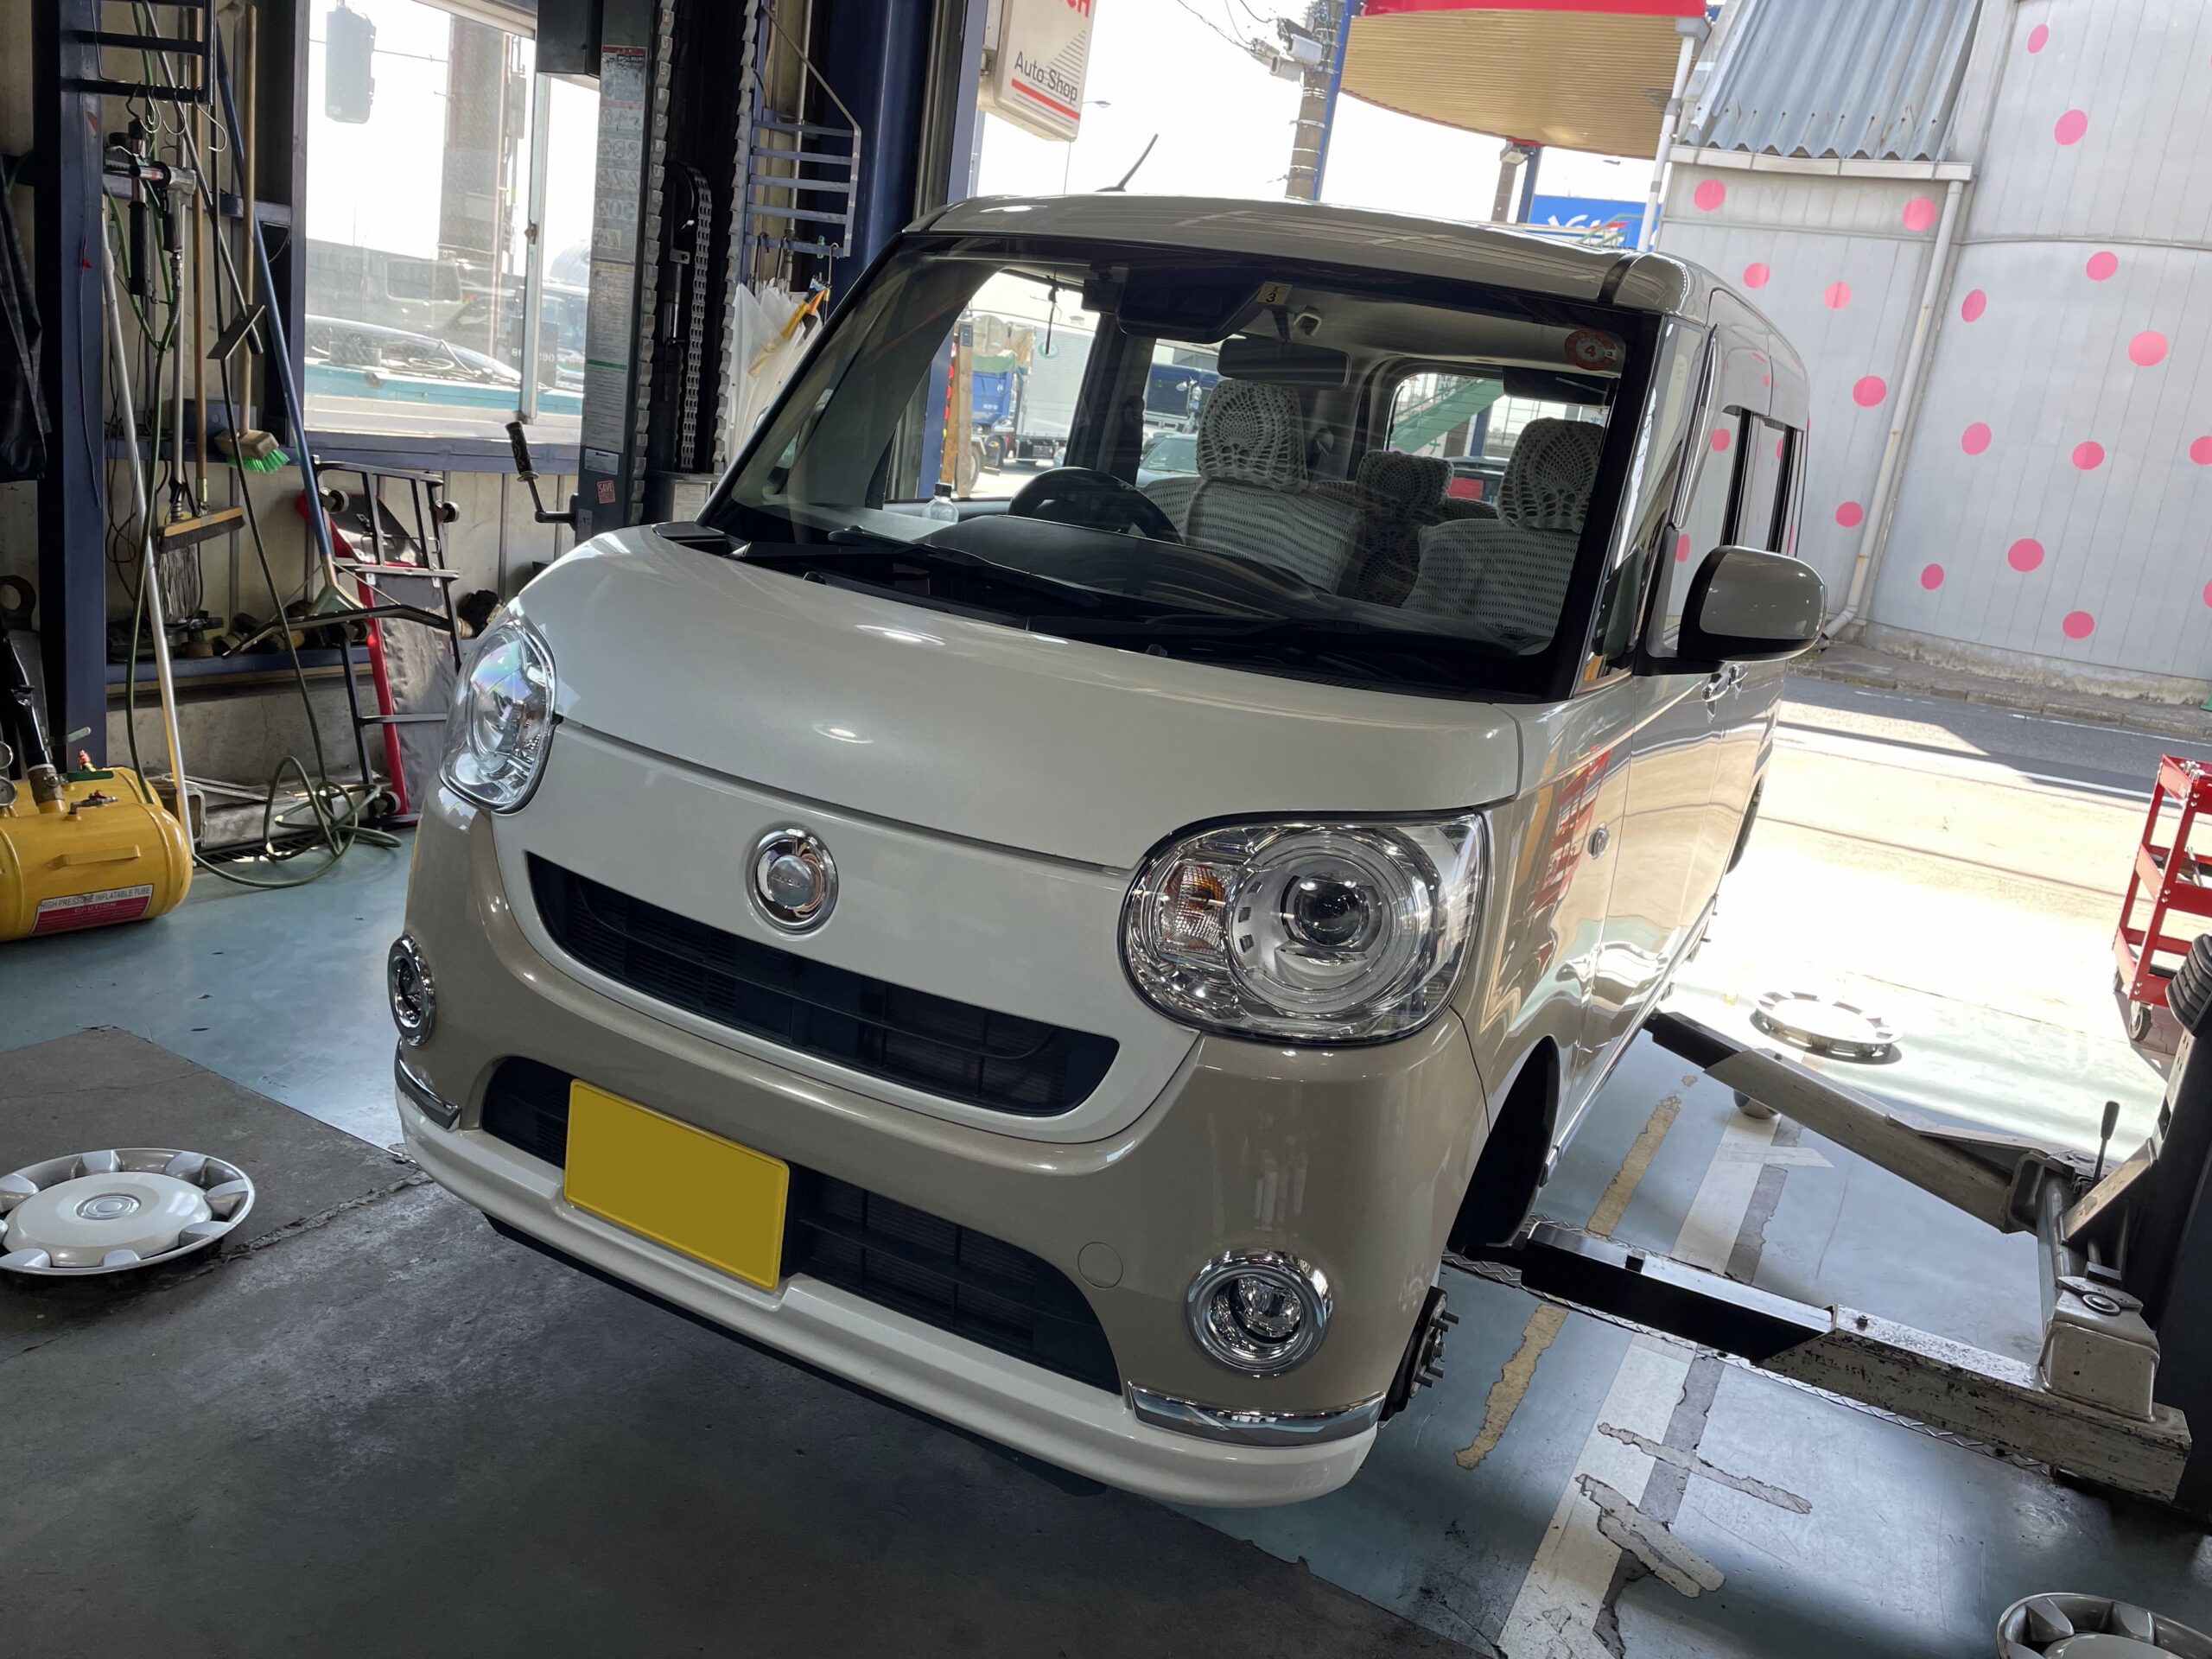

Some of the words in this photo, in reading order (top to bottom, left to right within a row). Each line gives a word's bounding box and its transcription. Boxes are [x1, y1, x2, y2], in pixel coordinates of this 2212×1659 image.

[1014, 51, 1045, 84] Auto
[1047, 69, 1077, 104] Shop
[1266, 293, 1276, 302] 3
[1585, 346, 1596, 357] 4
[40, 899, 58, 910] HIGH
[58, 894, 94, 906] PRESSURE
[95, 889, 133, 901] INFLATABLE
[134, 887, 150, 896] TUBE
[74, 902, 117, 913] CAUTION
